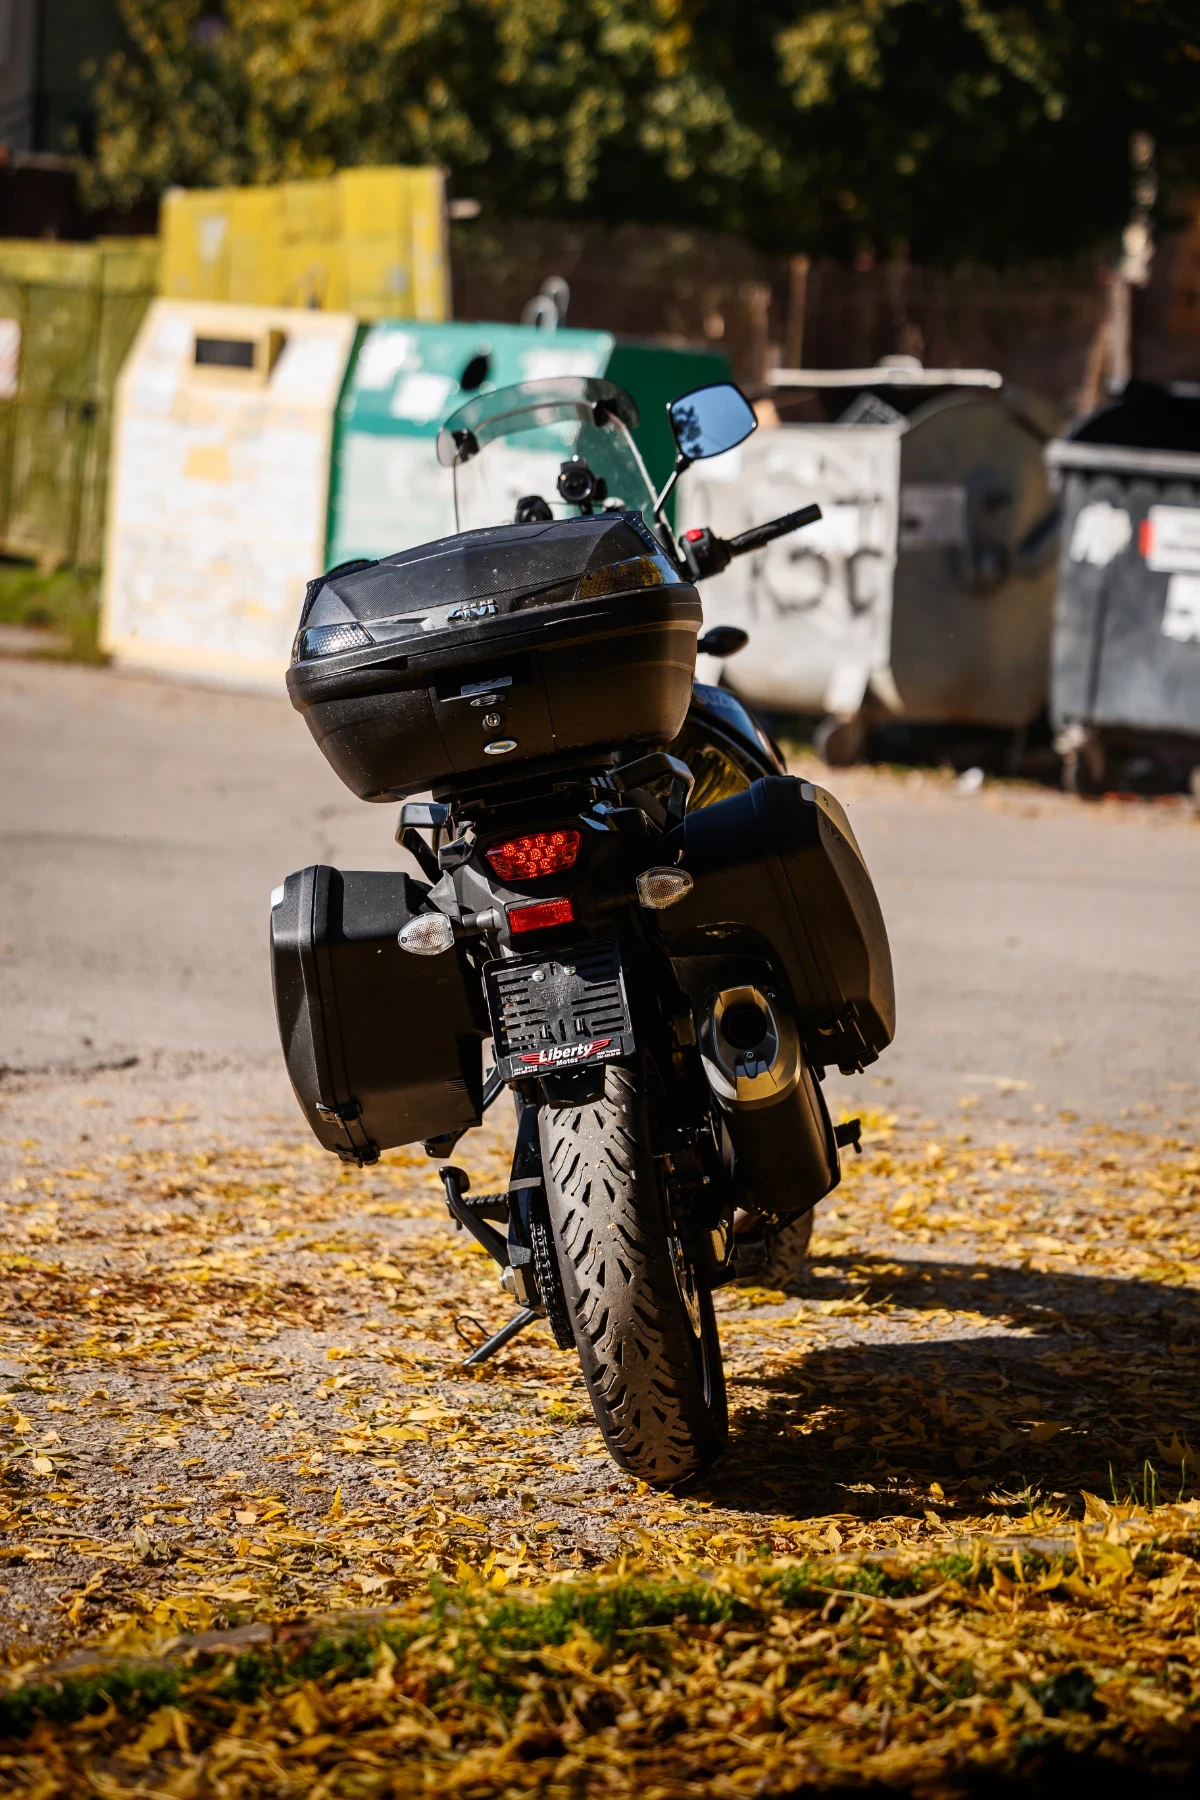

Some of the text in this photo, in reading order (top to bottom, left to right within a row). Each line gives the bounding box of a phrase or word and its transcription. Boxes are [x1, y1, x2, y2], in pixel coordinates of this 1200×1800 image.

[447, 599, 498, 622] GIVI
[538, 1043, 594, 1063] Liberty
[556, 1058, 579, 1067] Motos
